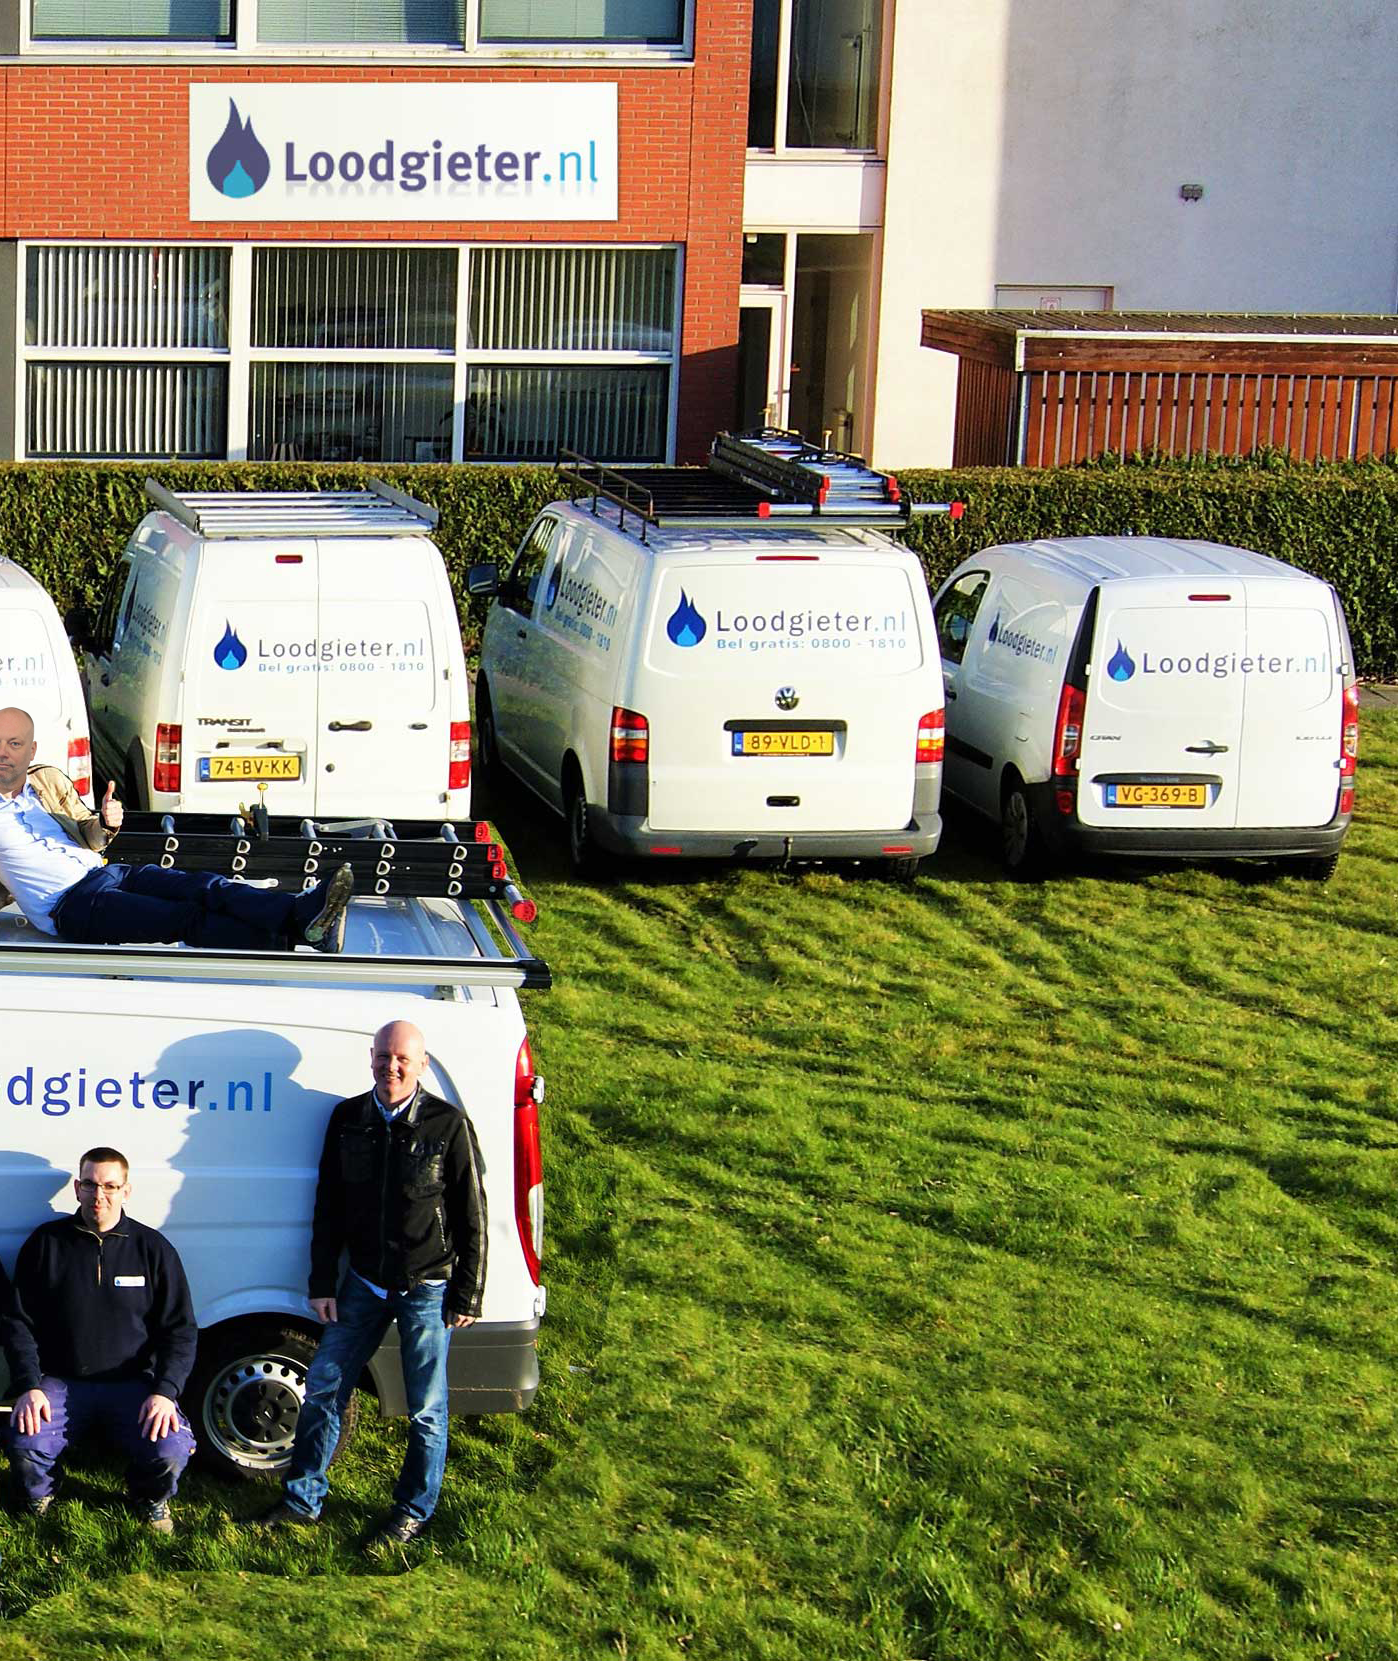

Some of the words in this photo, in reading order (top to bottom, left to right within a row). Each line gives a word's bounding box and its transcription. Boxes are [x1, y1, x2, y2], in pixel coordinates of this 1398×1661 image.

[285, 139, 599, 192] Loodgieter.nl
[717, 610, 906, 637] Loodgieter.nl
[258, 638, 424, 662] Loodgieter.nl
[717, 638, 743, 649] Bel
[749, 638, 805, 651] gratis:
[811, 638, 851, 649] 0800
[869, 638, 906, 649] 1810
[998, 625, 1059, 665] Loodgieter.nl
[258, 663, 281, 672] Bel
[286, 662, 334, 674] gratis:
[340, 662, 375, 672] 0800
[392, 662, 424, 671] 1810
[1143, 651, 1326, 679] Loodgieter.nl
[197, 718, 252, 726] TRANSIT
[751, 735, 823, 750] 89-VLD-1
[215, 760, 292, 775] 74-BV-KK
[1121, 787, 1198, 803] VG-369-B
